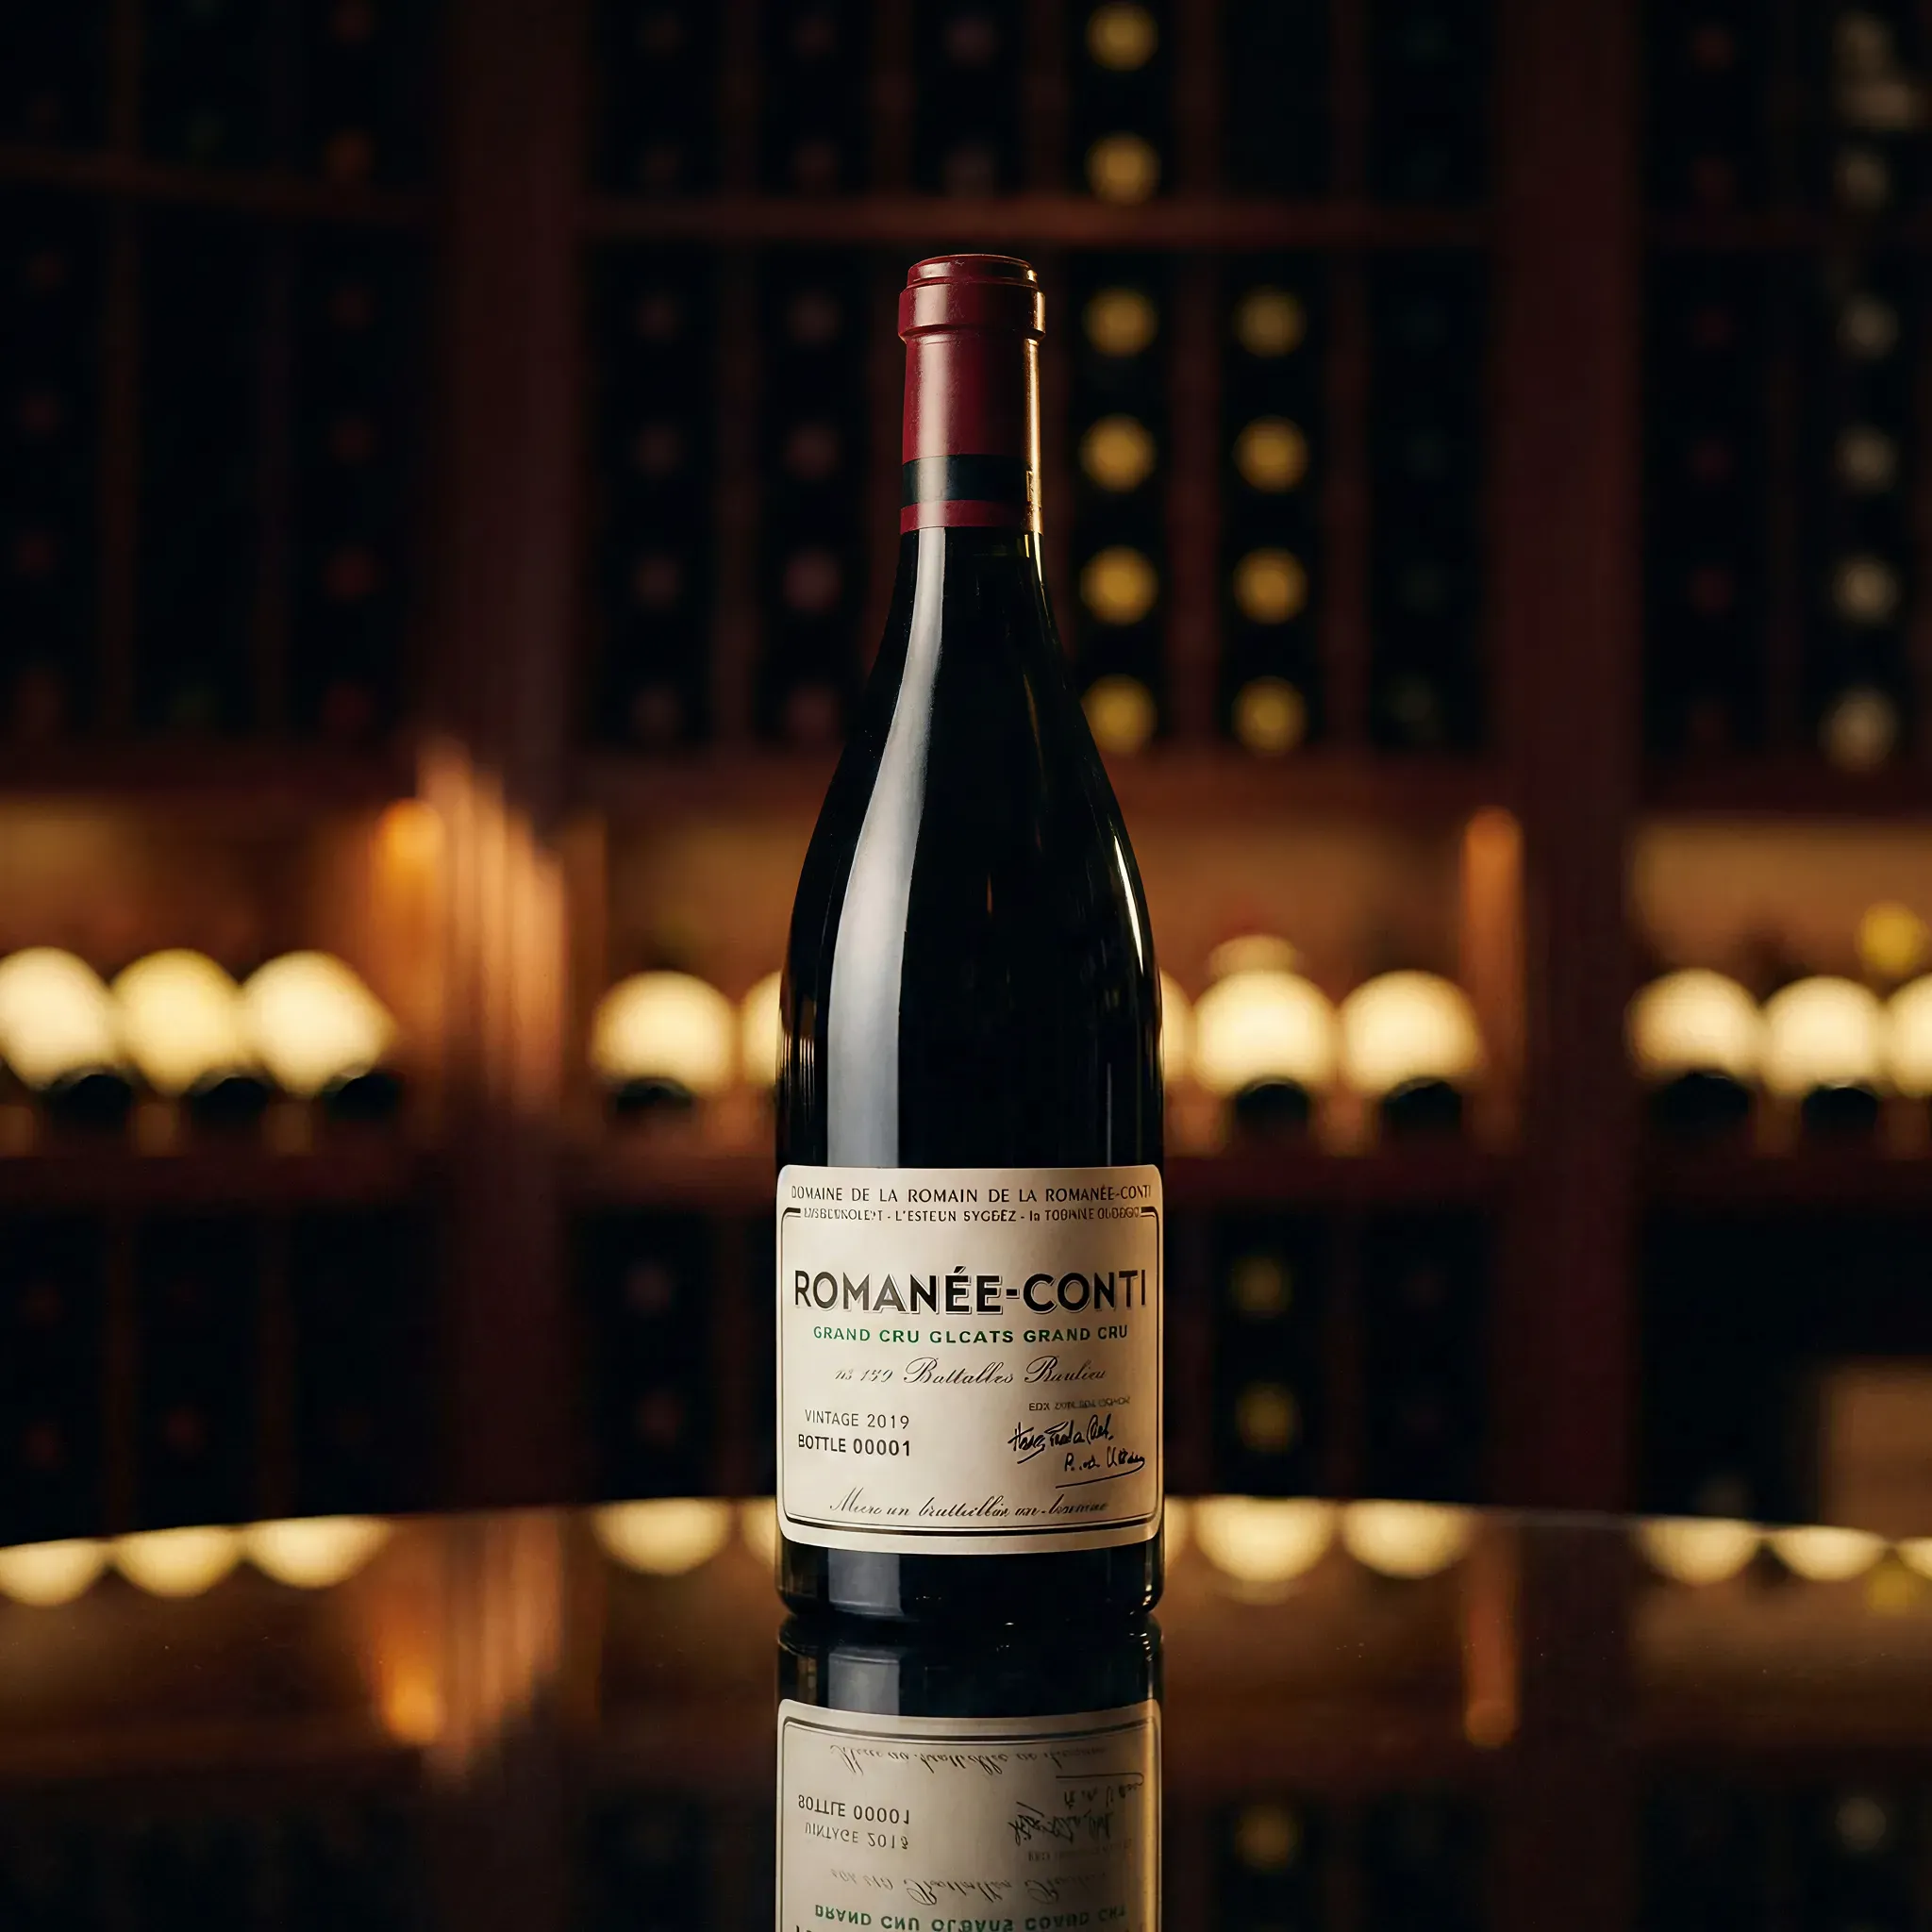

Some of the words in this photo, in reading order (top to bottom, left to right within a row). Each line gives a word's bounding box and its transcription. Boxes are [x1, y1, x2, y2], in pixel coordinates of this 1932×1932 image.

[791, 1185, 842, 1202] DOMAINE
[852, 1188, 870, 1202] DE
[879, 1189, 898, 1203] LA
[908, 1189, 977, 1204] ROMAIN
[989, 1189, 1009, 1203] DE
[1019, 1189, 1038, 1203] LA
[1045, 1184, 1151, 1203] ROMANÉE-CONTI
[794, 1266, 1147, 1315] ROMANÉE-CONTI
[812, 1325, 872, 1342] GRAND
[878, 1328, 920, 1344] CRU
[928, 1330, 1015, 1344] GLCATS
[1023, 1327, 1091, 1343] GRAND
[1097, 1324, 1128, 1341] CRU
[804, 1408, 859, 1427] VINTAGE
[866, 1413, 910, 1430] 2019
[798, 1433, 847, 1454] BOTTLE
[853, 1438, 911, 1457] 00001
